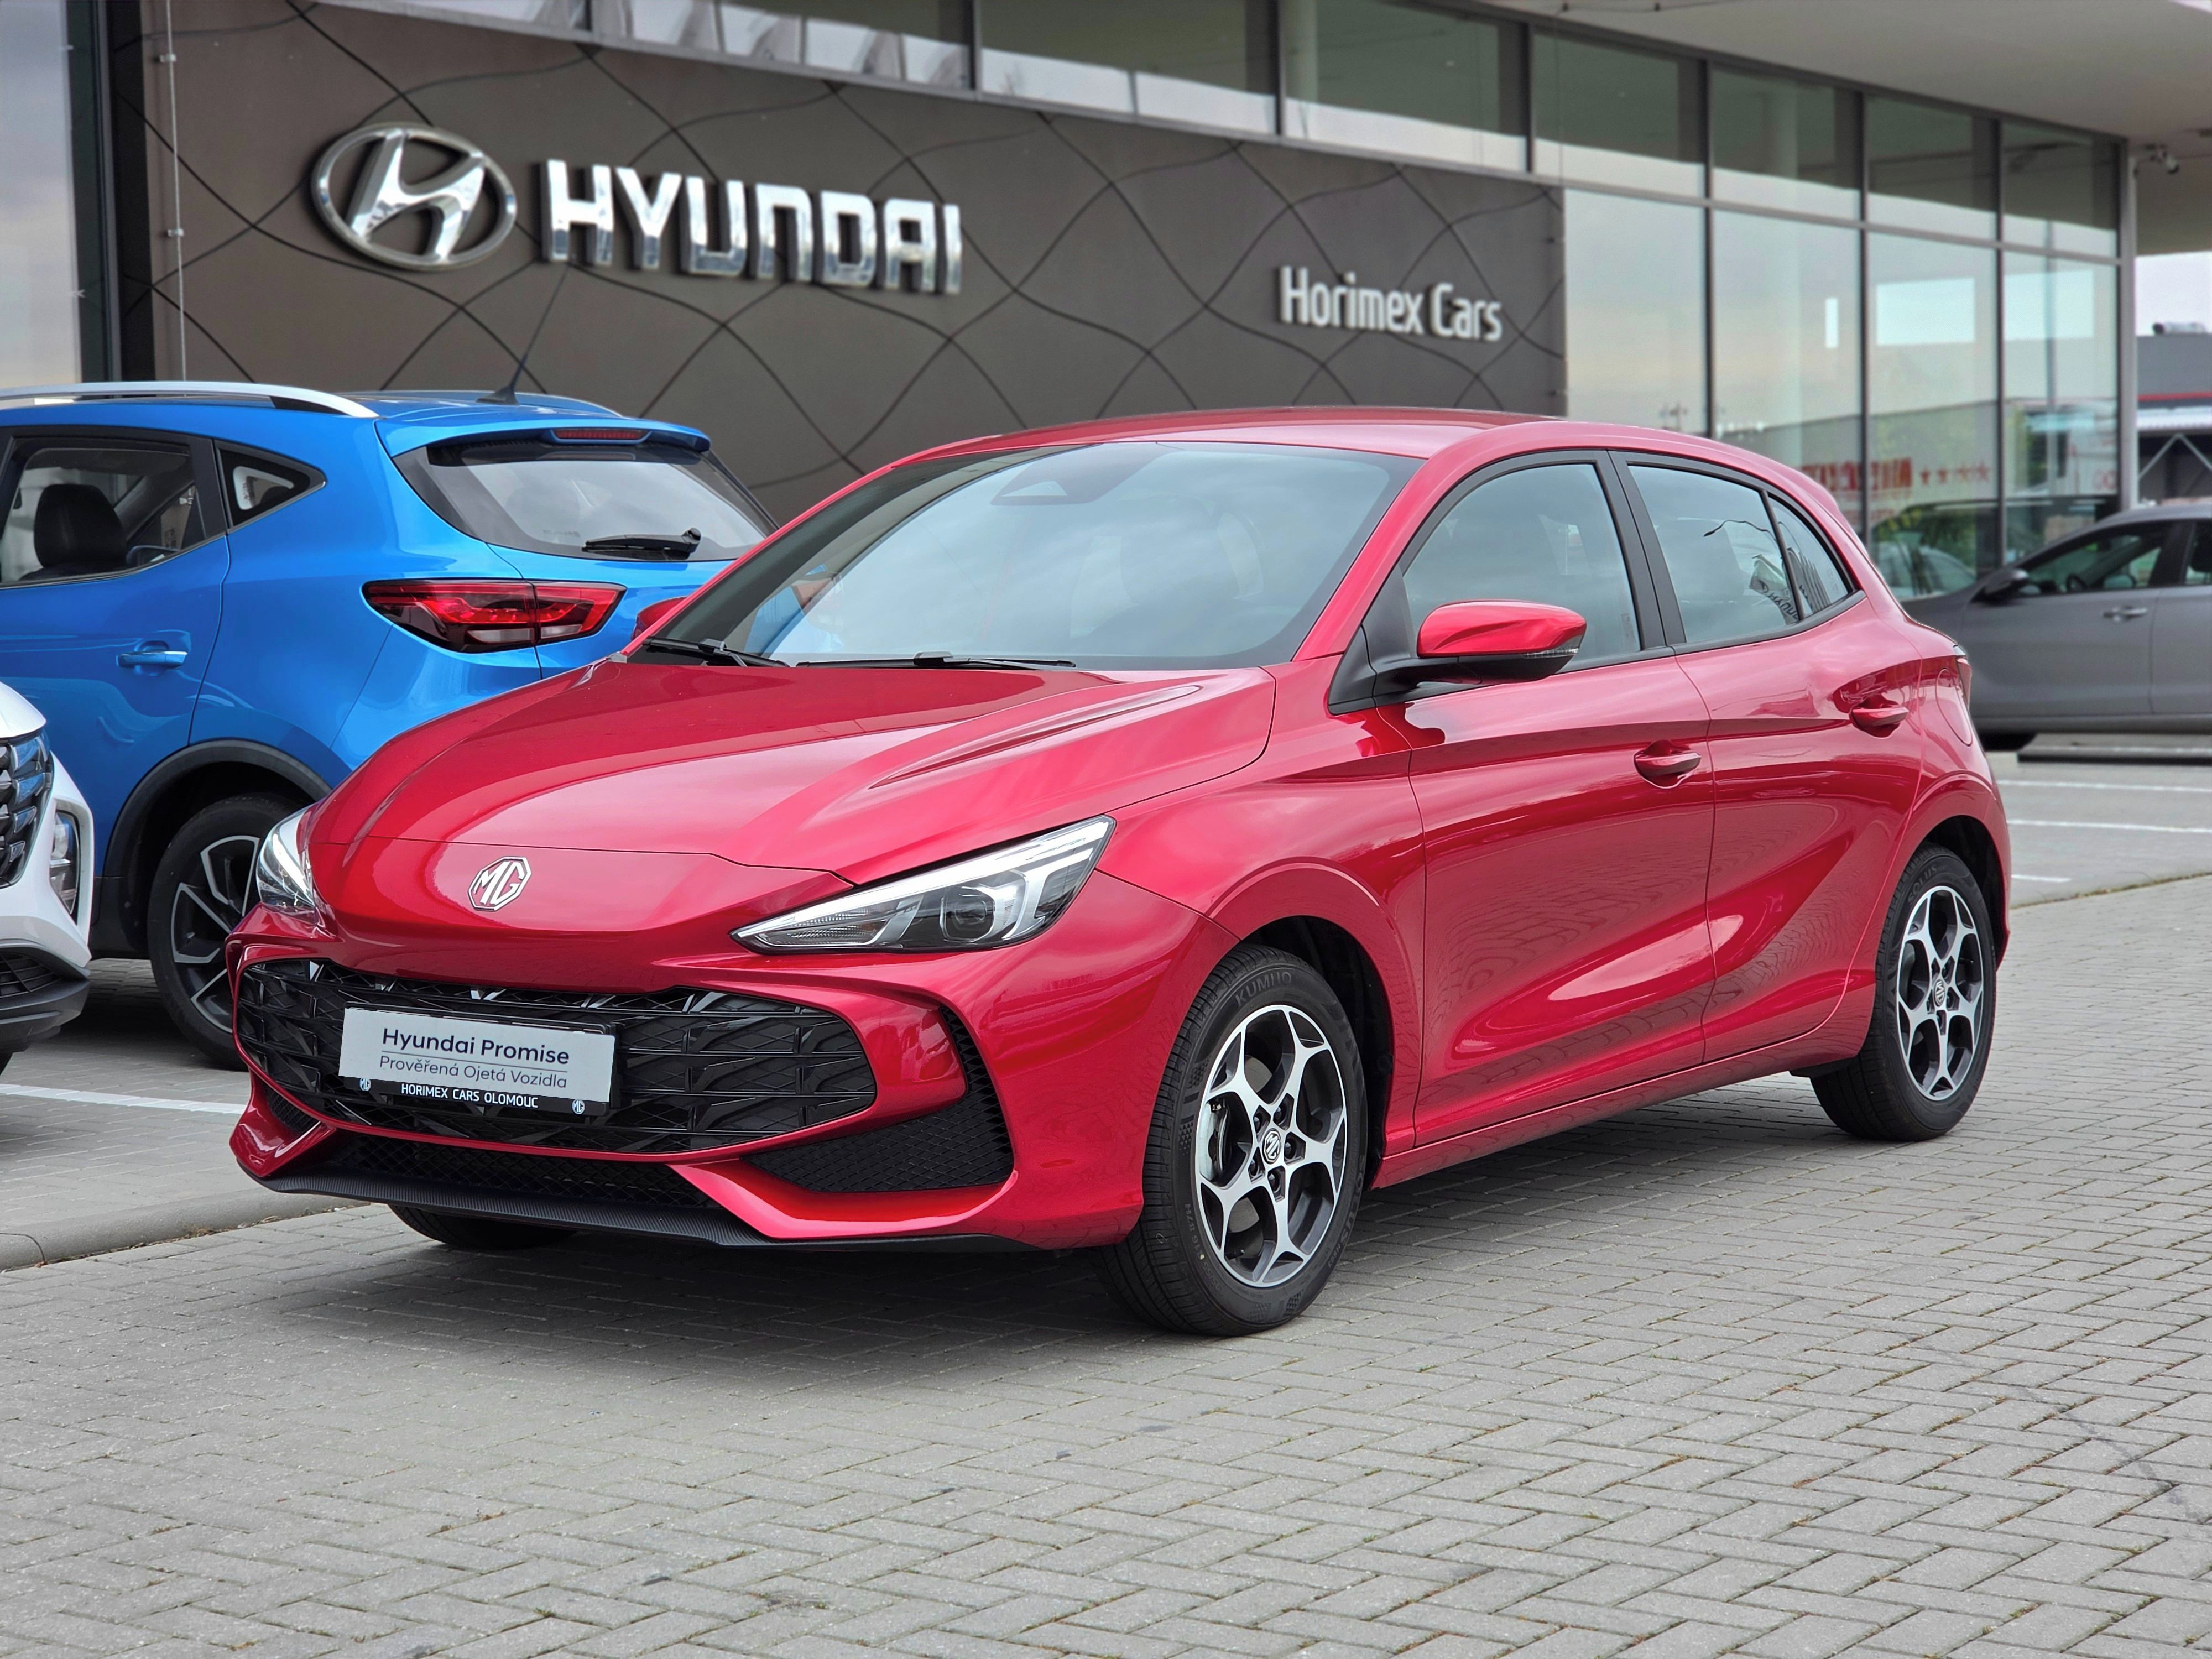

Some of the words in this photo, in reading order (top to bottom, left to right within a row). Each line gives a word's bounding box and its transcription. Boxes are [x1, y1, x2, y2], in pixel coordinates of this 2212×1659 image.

[545, 159, 962, 294] HYUNDAI
[1279, 265, 1424, 335] Horimex
[1428, 282, 1503, 342] Cars
[472, 859, 528, 906] MG
[1235, 971, 1292, 1007] KUMHO
[382, 1027, 475, 1055] Hyundai
[480, 1039, 570, 1065] Promise
[359, 1077, 371, 1092] MG
[379, 1055, 459, 1077] Prověřená
[463, 1064, 507, 1083] Ojetá
[510, 1070, 568, 1089] Vozidla
[400, 1083, 448, 1099] HORIMEX
[452, 1088, 479, 1103] CARS
[483, 1093, 538, 1109] OLOMOUC
[572, 1099, 585, 1114] MG
[1265, 1132, 1280, 1161] MG
